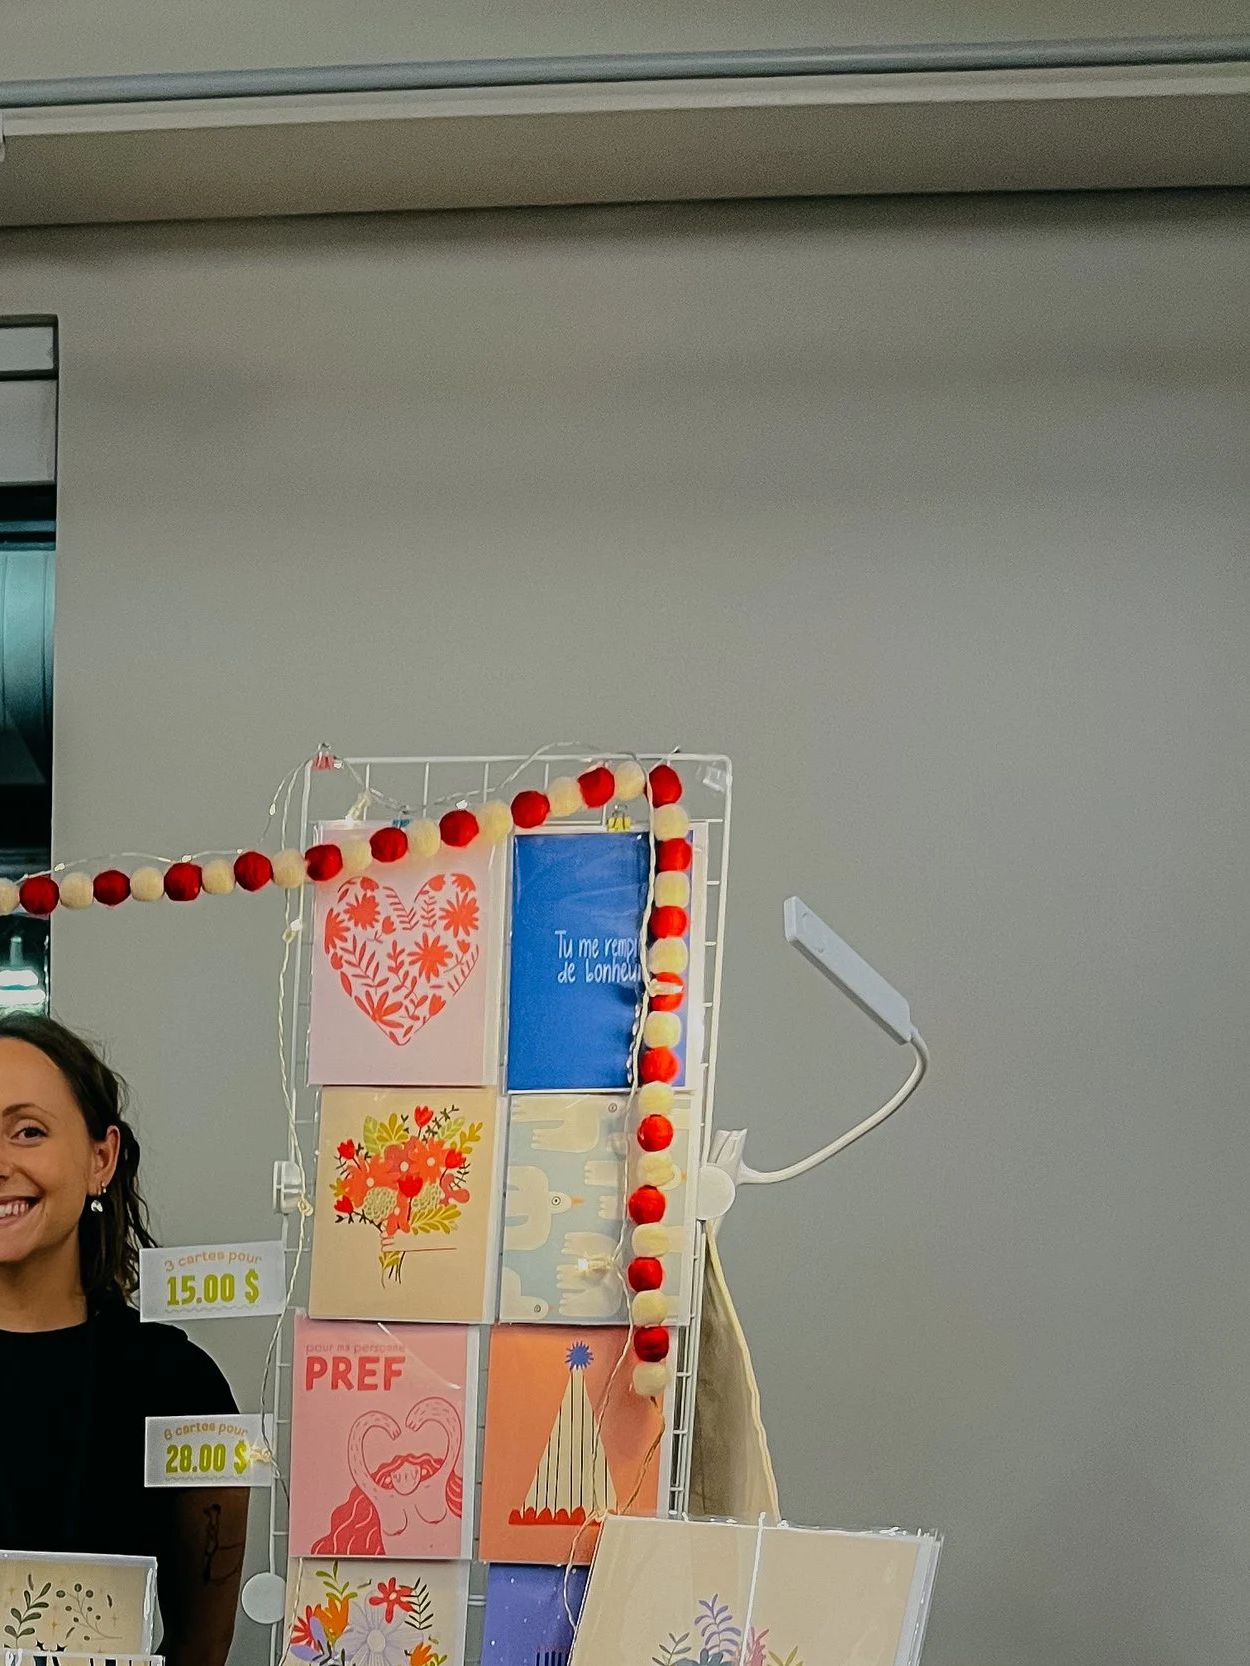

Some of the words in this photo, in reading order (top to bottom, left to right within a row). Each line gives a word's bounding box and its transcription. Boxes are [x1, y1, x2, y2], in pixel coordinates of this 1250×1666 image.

[554, 930, 573, 959] Tu
[578, 938, 600, 959] me
[557, 960, 576, 983] de
[166, 1273, 236, 1306] 15.00
[244, 1268, 259, 1304] $
[305, 1355, 407, 1391] PREF
[165, 1443, 227, 1474] 28.00
[233, 1440, 249, 1475] $
